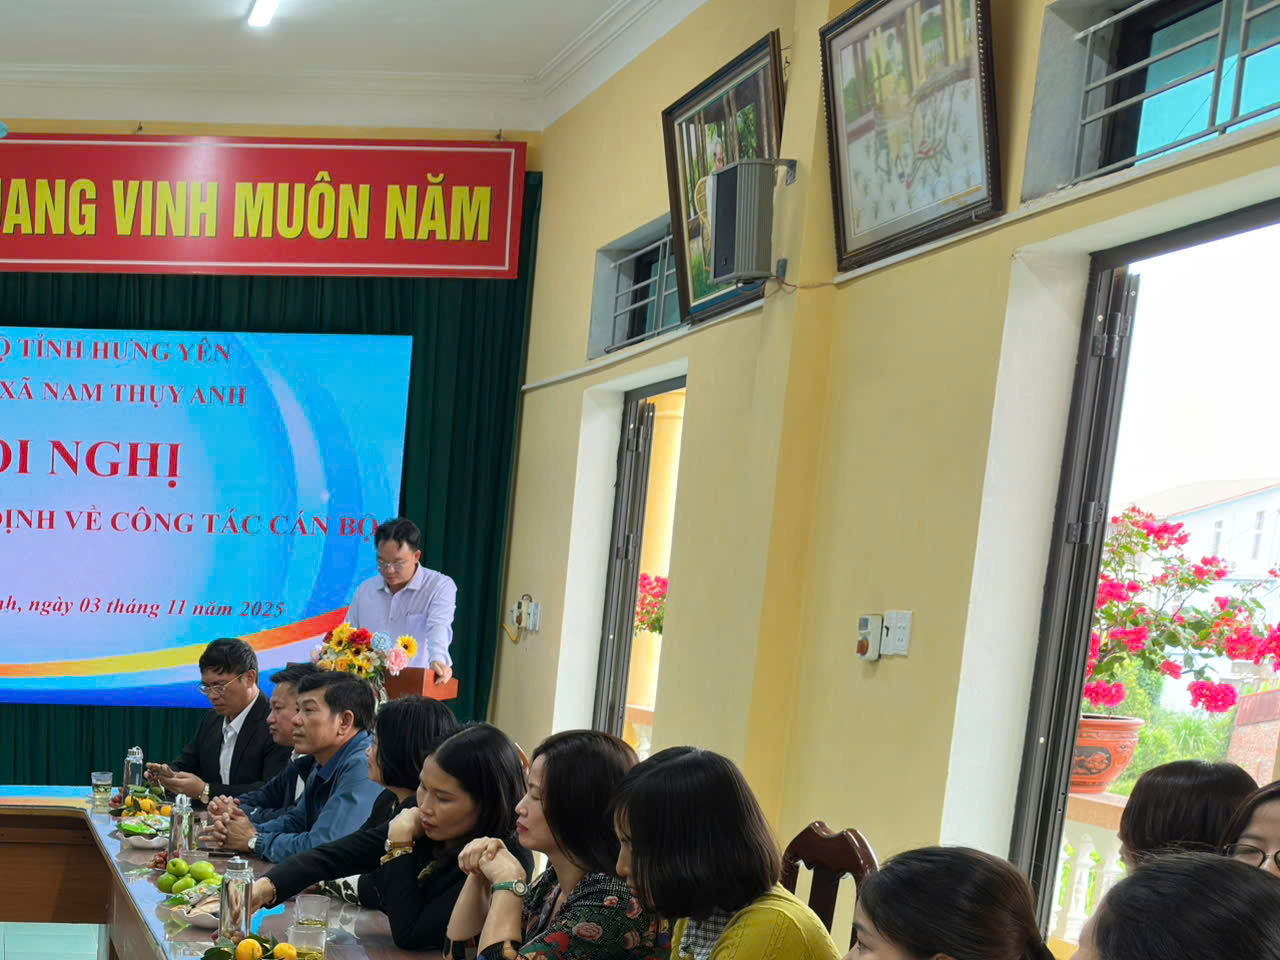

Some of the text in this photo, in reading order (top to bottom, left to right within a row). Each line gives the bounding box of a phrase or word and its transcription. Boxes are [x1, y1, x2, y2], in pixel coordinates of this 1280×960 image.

[113, 179, 218, 238] VINH
[234, 171, 370, 240] MUÔN
[385, 173, 492, 241] NĂM
[93, 338, 170, 361] HƯNG
[179, 338, 232, 362] YÊN
[0, 377, 34, 400] XÃ
[43, 382, 102, 402] NAM
[111, 384, 184, 408] THỤY
[190, 386, 248, 406] ANH
[48, 440, 183, 488] NGHỊ
[64, 504, 102, 531] VỀ
[111, 506, 193, 533] CÔNG
[202, 507, 261, 535] TÁC
[270, 508, 329, 537] CÁN
[339, 514, 379, 543] BỘ
[28, 596, 74, 616] ngày
[79, 597, 101, 613] 03
[106, 598, 161, 618] tháng
[168, 599, 186, 615] 11
[192, 600, 233, 616] năm
[239, 601, 285, 618] 2025
